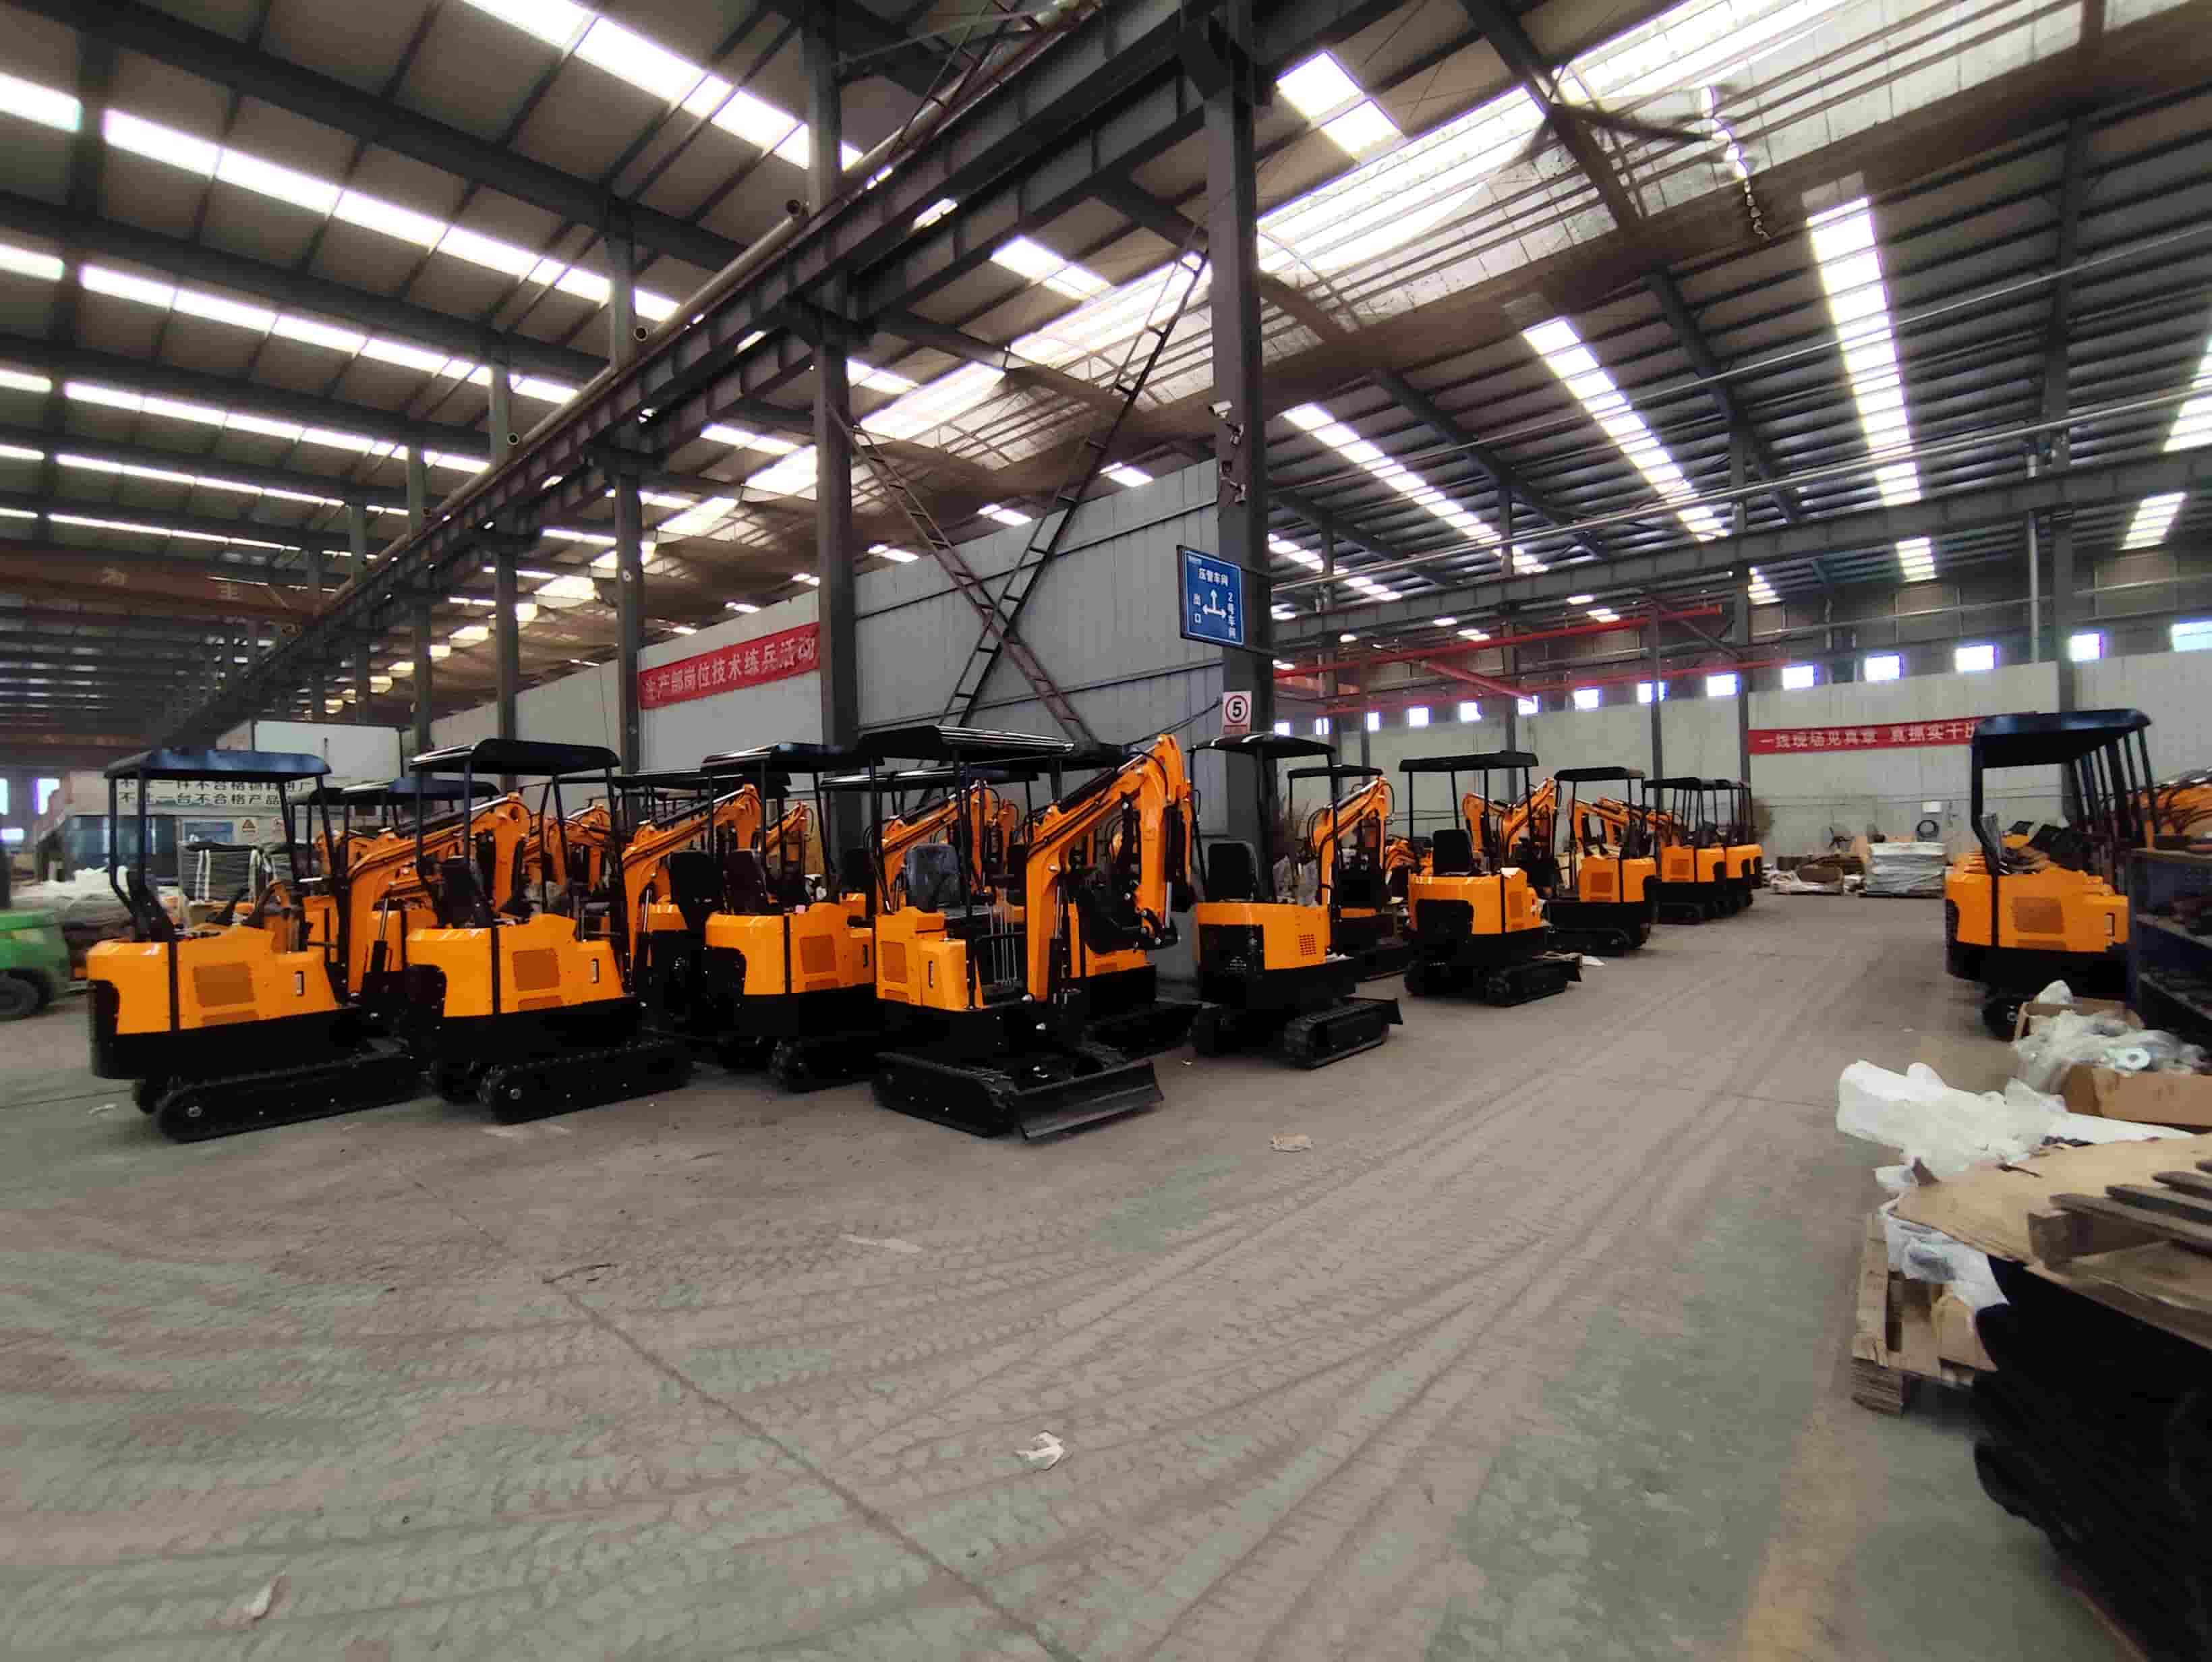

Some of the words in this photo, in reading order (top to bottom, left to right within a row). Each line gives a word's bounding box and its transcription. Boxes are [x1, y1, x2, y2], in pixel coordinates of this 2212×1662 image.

[645, 635, 815, 701] 生产部岗位技术练兵活动
[1232, 701, 1242, 718] 5
